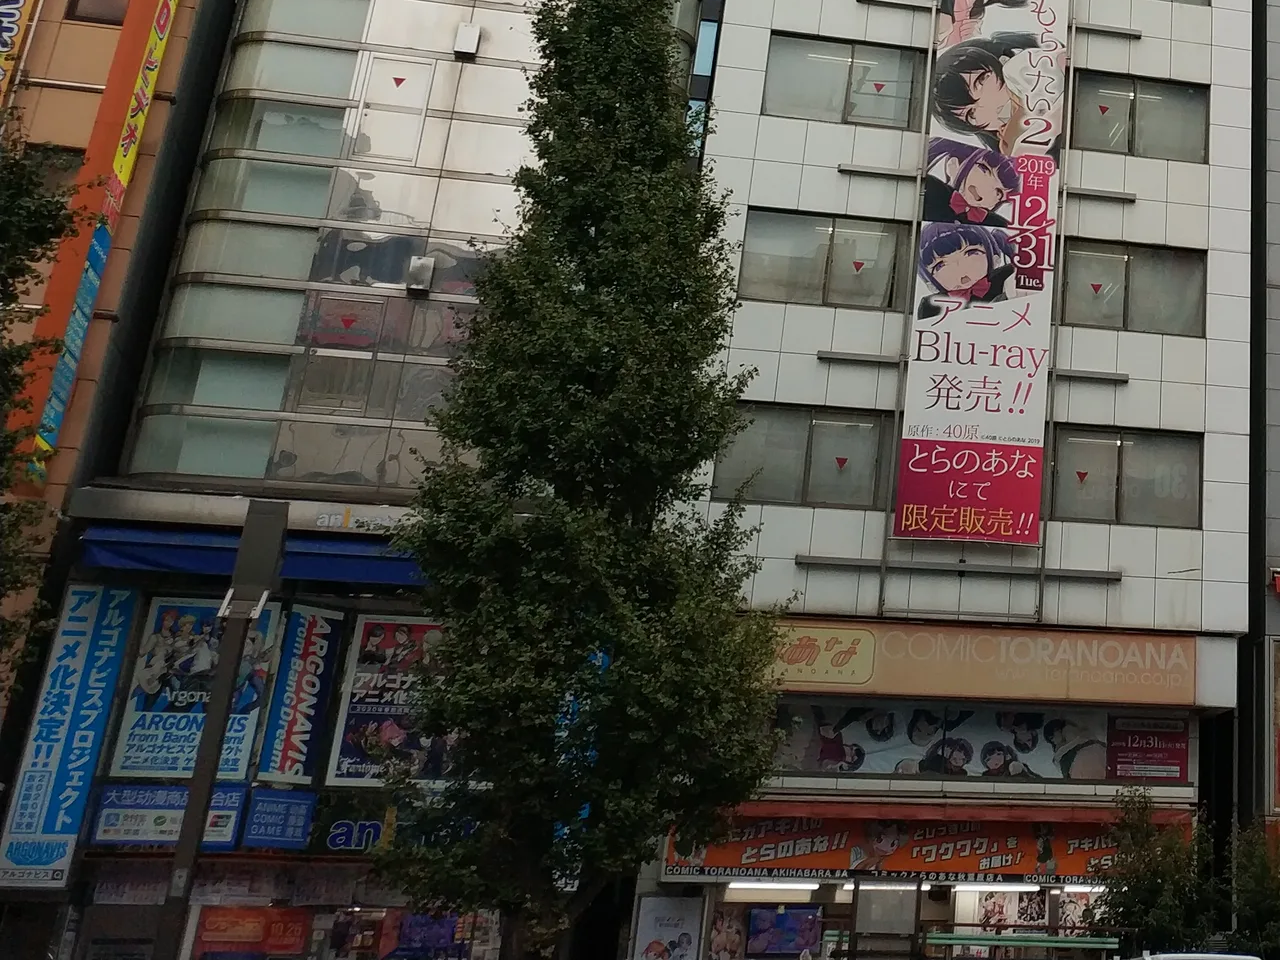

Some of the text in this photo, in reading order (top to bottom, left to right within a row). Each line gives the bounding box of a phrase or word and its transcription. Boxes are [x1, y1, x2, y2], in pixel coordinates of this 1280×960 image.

[1017, 157, 1056, 175] 2019
[1017, 273, 1044, 289] Tue.
[930, 298, 1033, 333] アニメ
[912, 329, 1050, 379] Blu-ray
[924, 373, 1034, 415] 発売!!
[908, 443, 1038, 479] とらのあな
[949, 480, 991, 501] にて
[901, 503, 1034, 536] 限定販売!!
[286, 613, 335, 779] ARGONAVIS
[54, 587, 133, 833] アルゴナビスプロジェクト
[130, 712, 248, 733] ARGONIS
[127, 731, 160, 743] from
[122, 743, 243, 758] アルゴナビスプクト
[103, 789, 242, 809] 大型动漫商品合店
[251, 824, 283, 836] GAME
[5, 840, 69, 867] ARGONAVIS
[741, 831, 850, 865] とらのあな!!
[1, 868, 50, 881] アルゴナビス
[665, 865, 701, 876] COMIC
[703, 866, 768, 878] TORANOANA
[771, 868, 831, 879] AKIHABARA
[1025, 874, 1057, 884] COMIC
